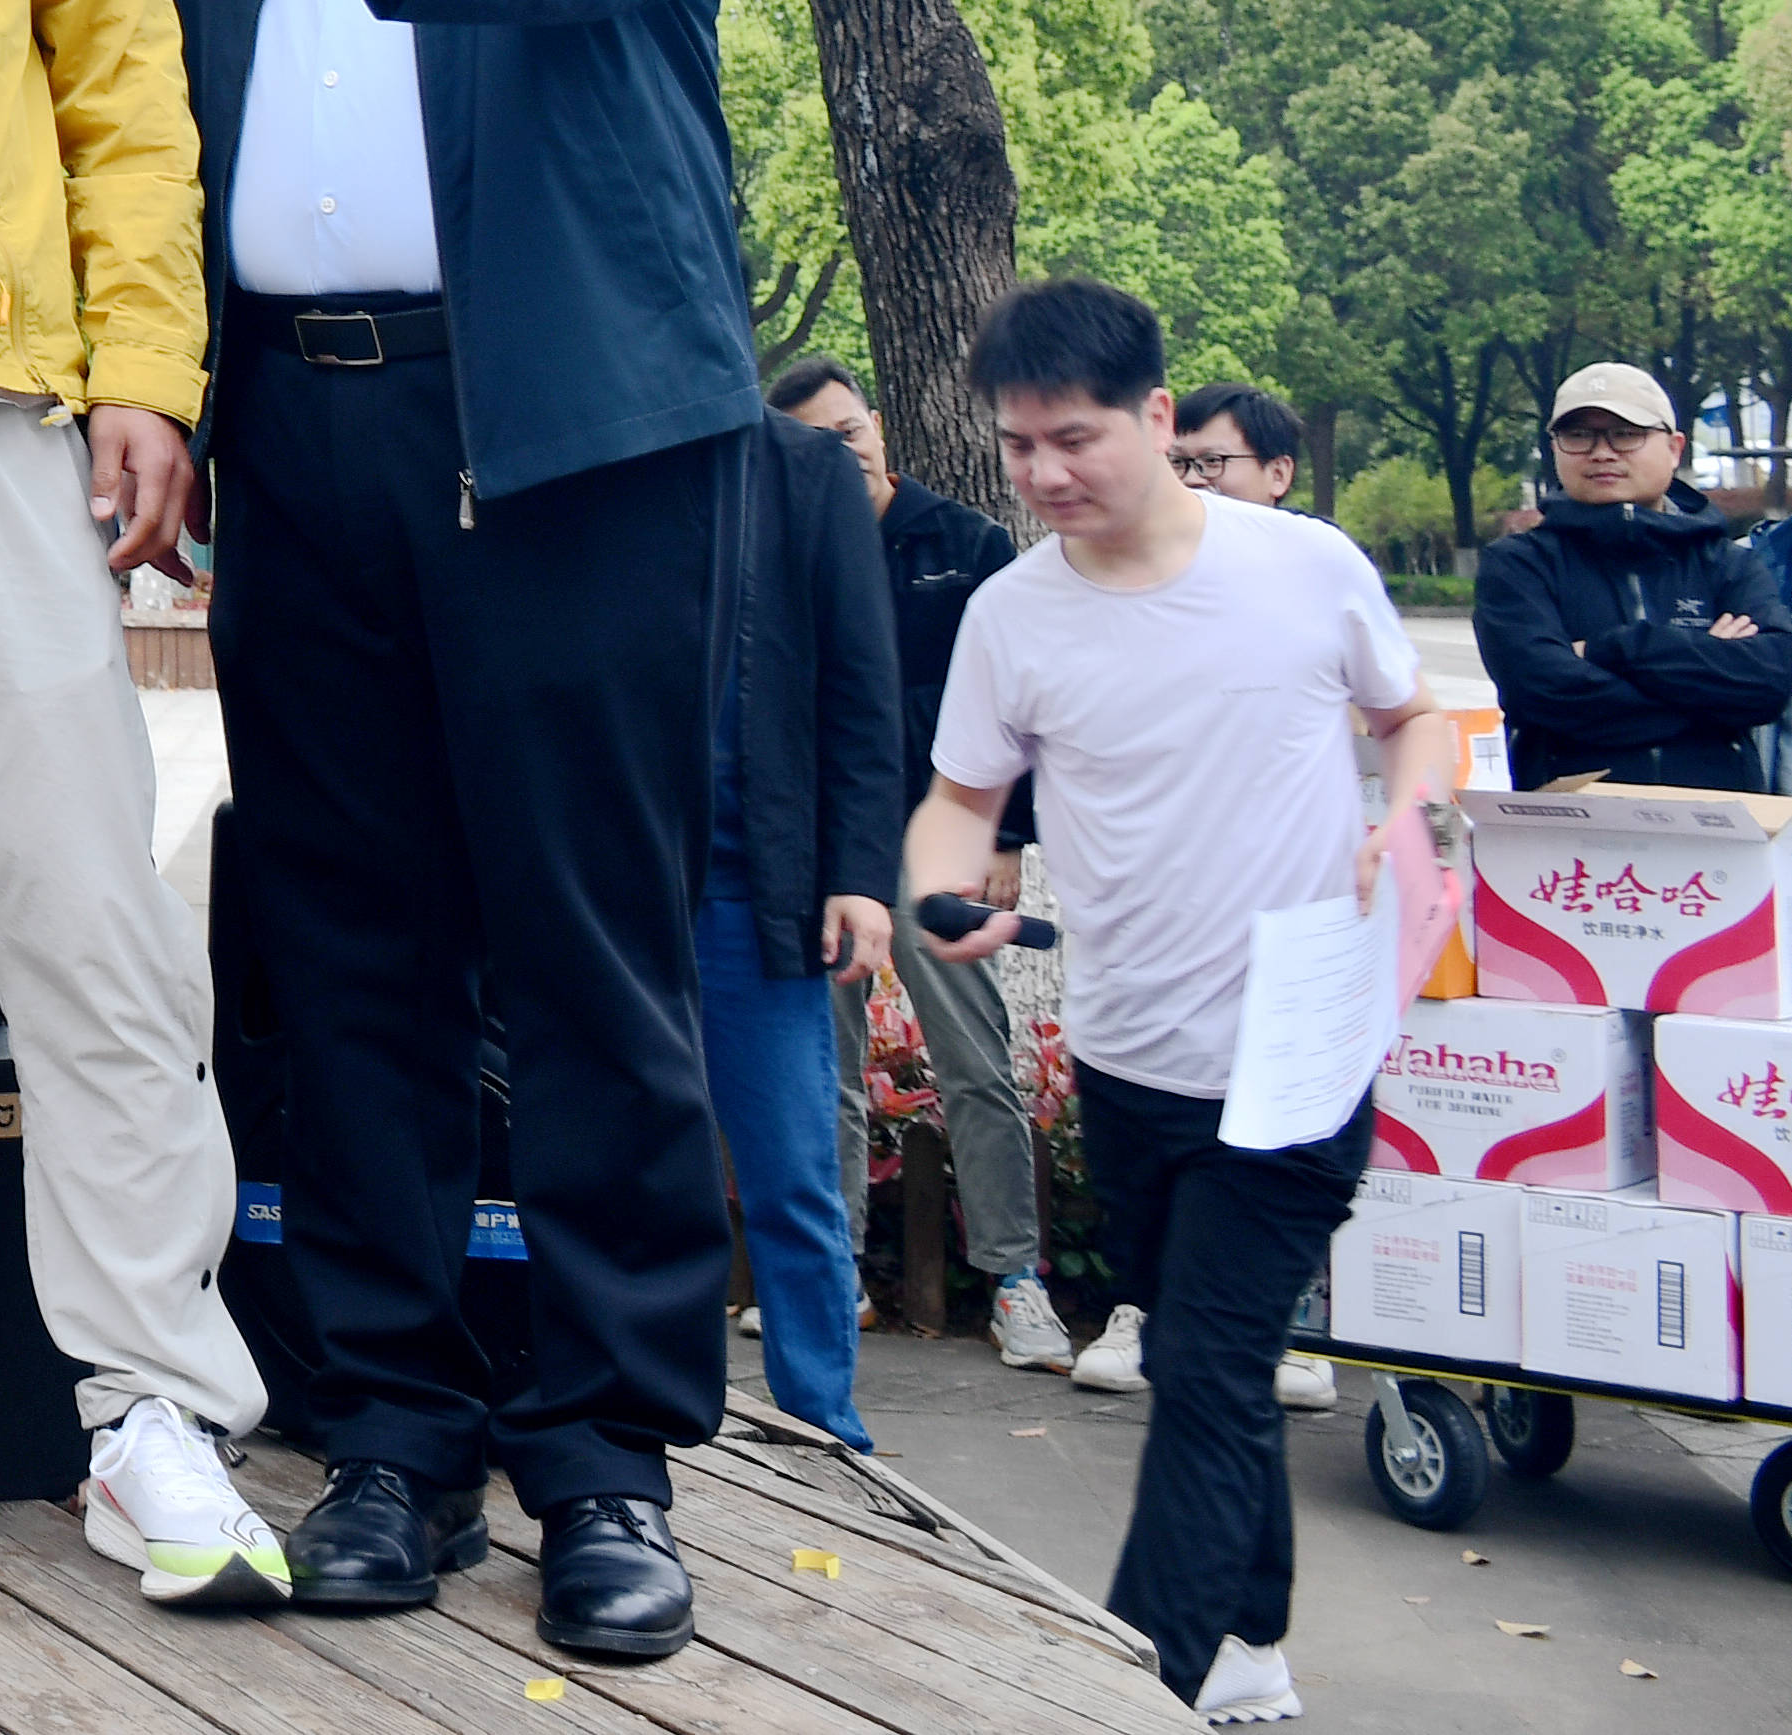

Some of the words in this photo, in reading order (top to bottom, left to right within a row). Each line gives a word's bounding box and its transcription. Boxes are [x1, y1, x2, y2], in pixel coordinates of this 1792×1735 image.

[1528, 856, 1722, 917] 娃哈哈
[1582, 920, 1666, 942] 饮用纯净水
